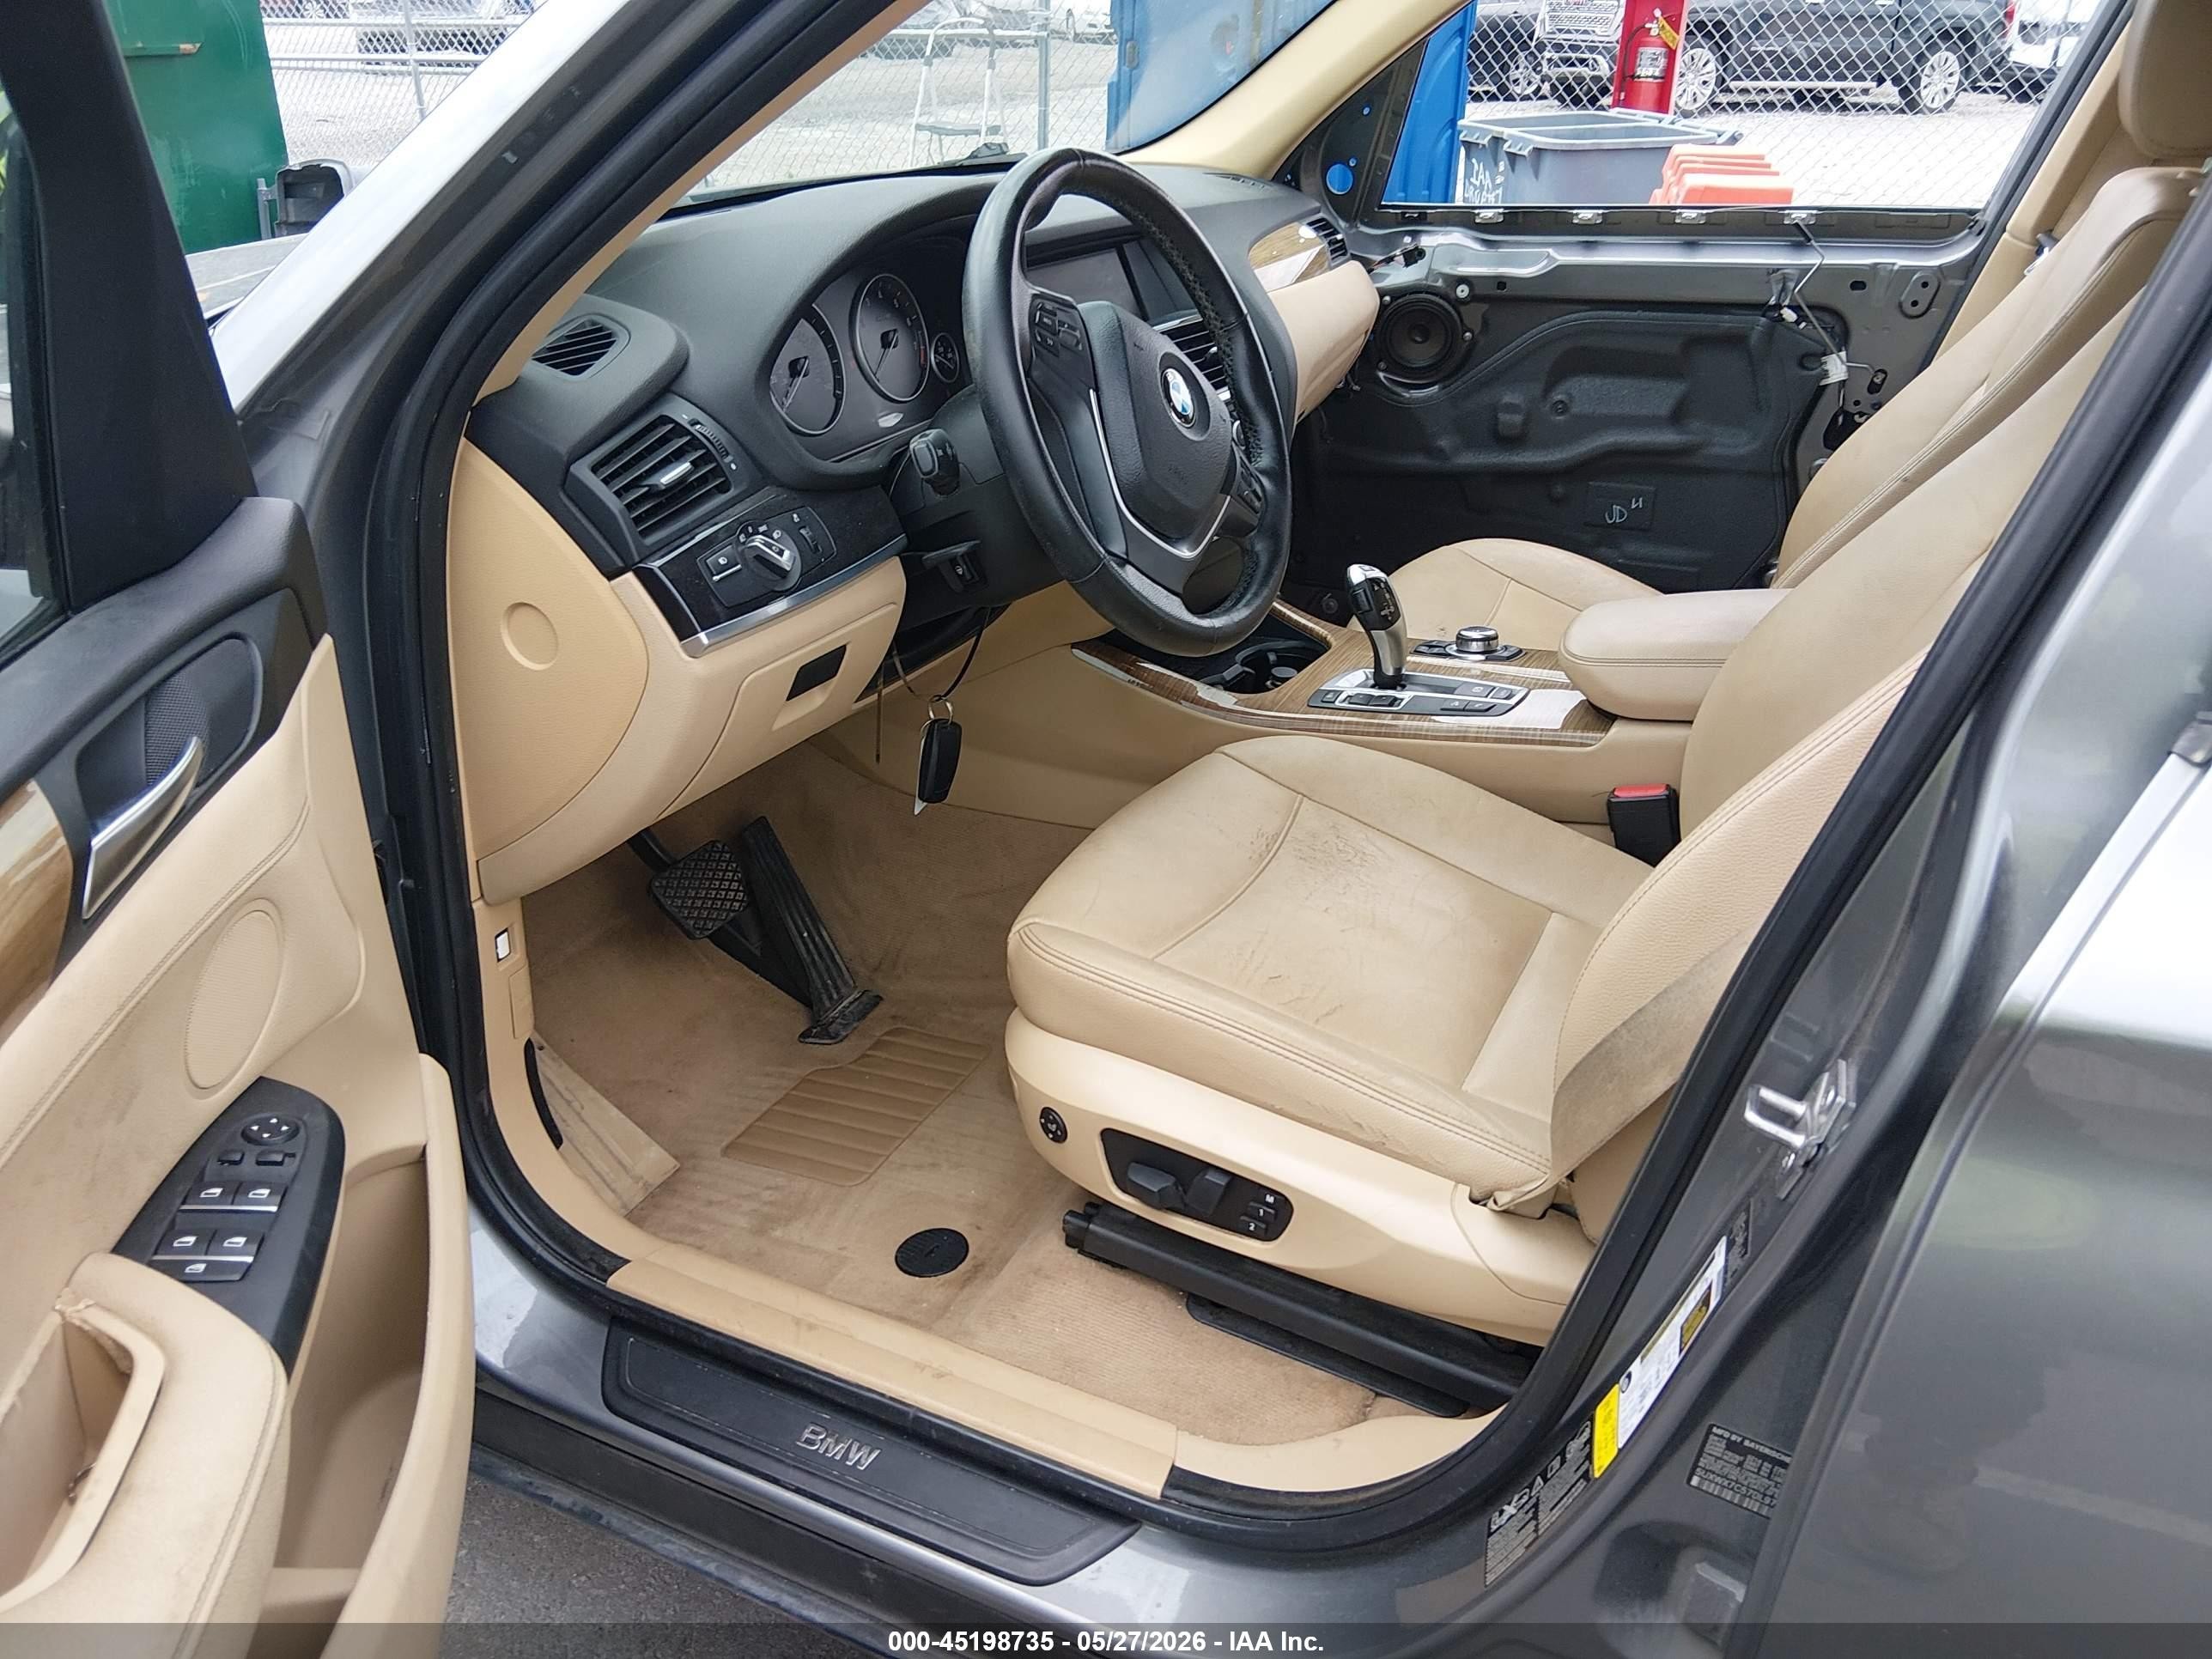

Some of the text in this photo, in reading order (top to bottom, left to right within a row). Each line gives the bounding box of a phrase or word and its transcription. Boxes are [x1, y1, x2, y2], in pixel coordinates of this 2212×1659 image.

[1265, 1194, 1275, 1204] M
[1258, 1208, 1264, 1217] 1
[1249, 1222, 1255, 1231] 2
[796, 1422, 882, 1470] BMW
